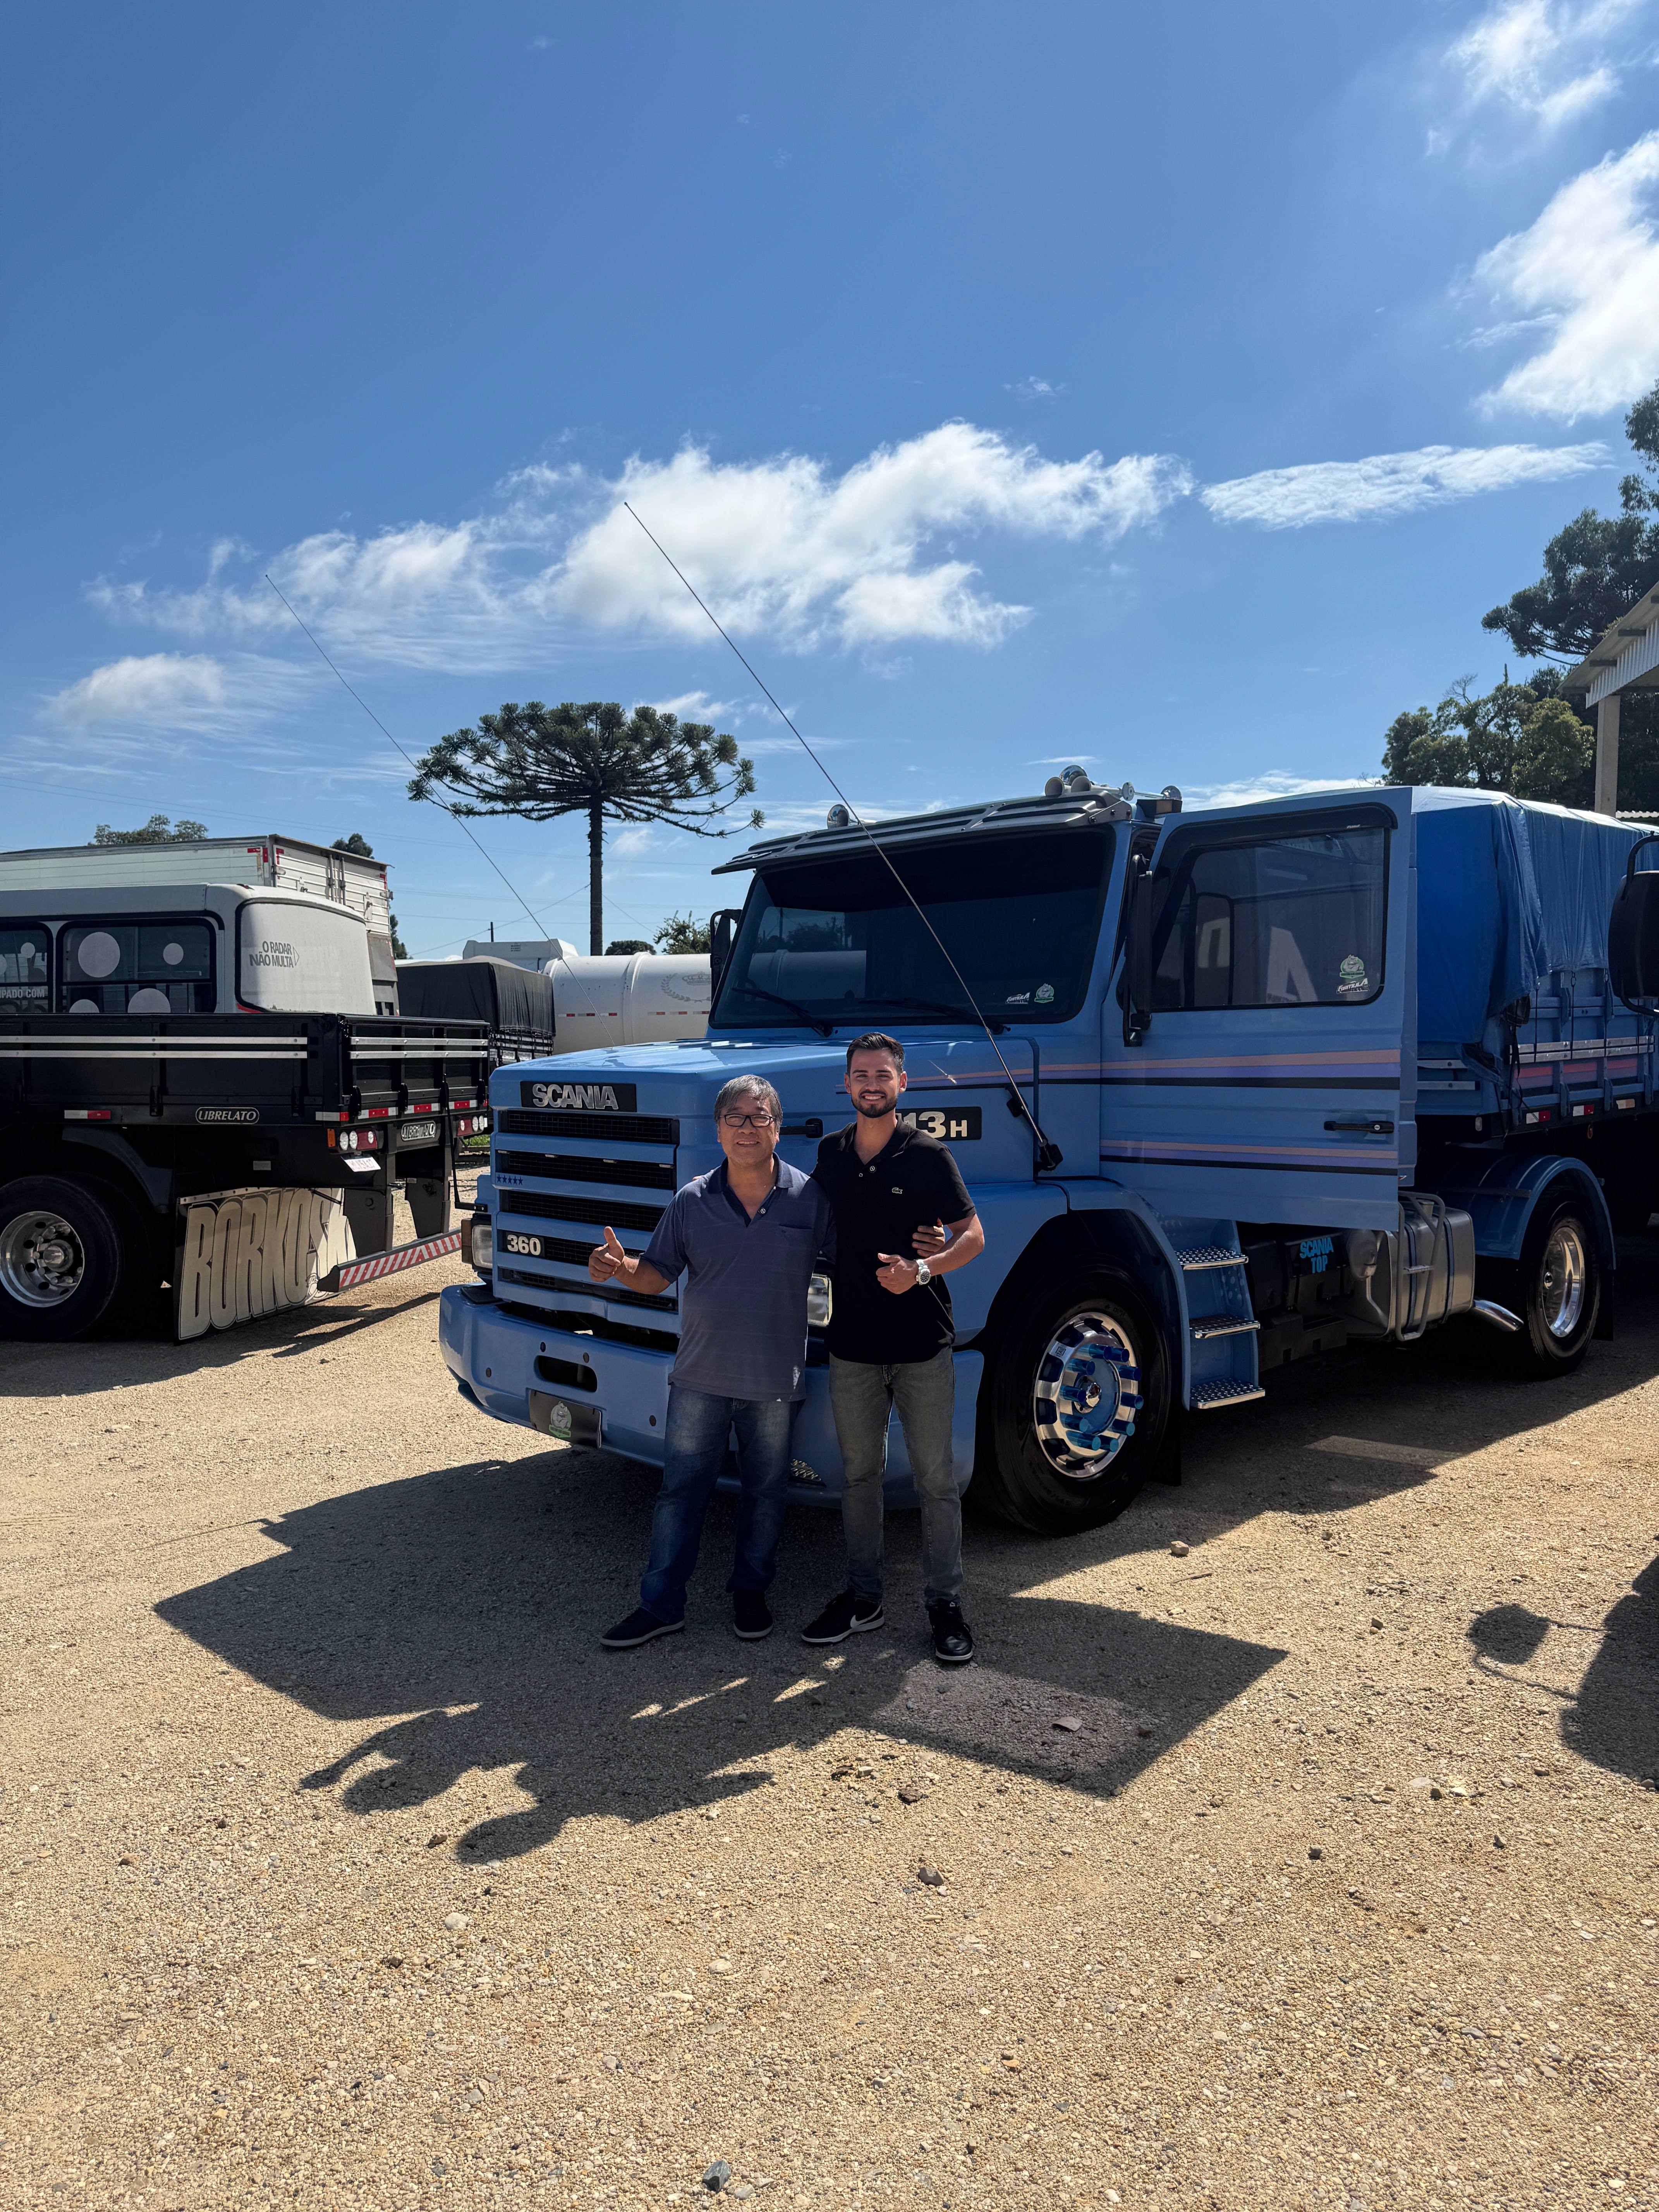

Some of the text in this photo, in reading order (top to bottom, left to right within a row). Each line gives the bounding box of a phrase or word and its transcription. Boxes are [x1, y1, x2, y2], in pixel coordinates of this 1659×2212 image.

[263, 941, 292, 955] O RADAR
[249, 951, 294, 968] NÃO MULTA
[26, 989, 45, 998] COM
[532, 1084, 619, 1110] SCANIA
[198, 1111, 256, 1120] LIBRELATO
[507, 1234, 541, 1255] 360
[1300, 1237, 1334, 1259] SCANIA
[1311, 1255, 1328, 1274] TOP
